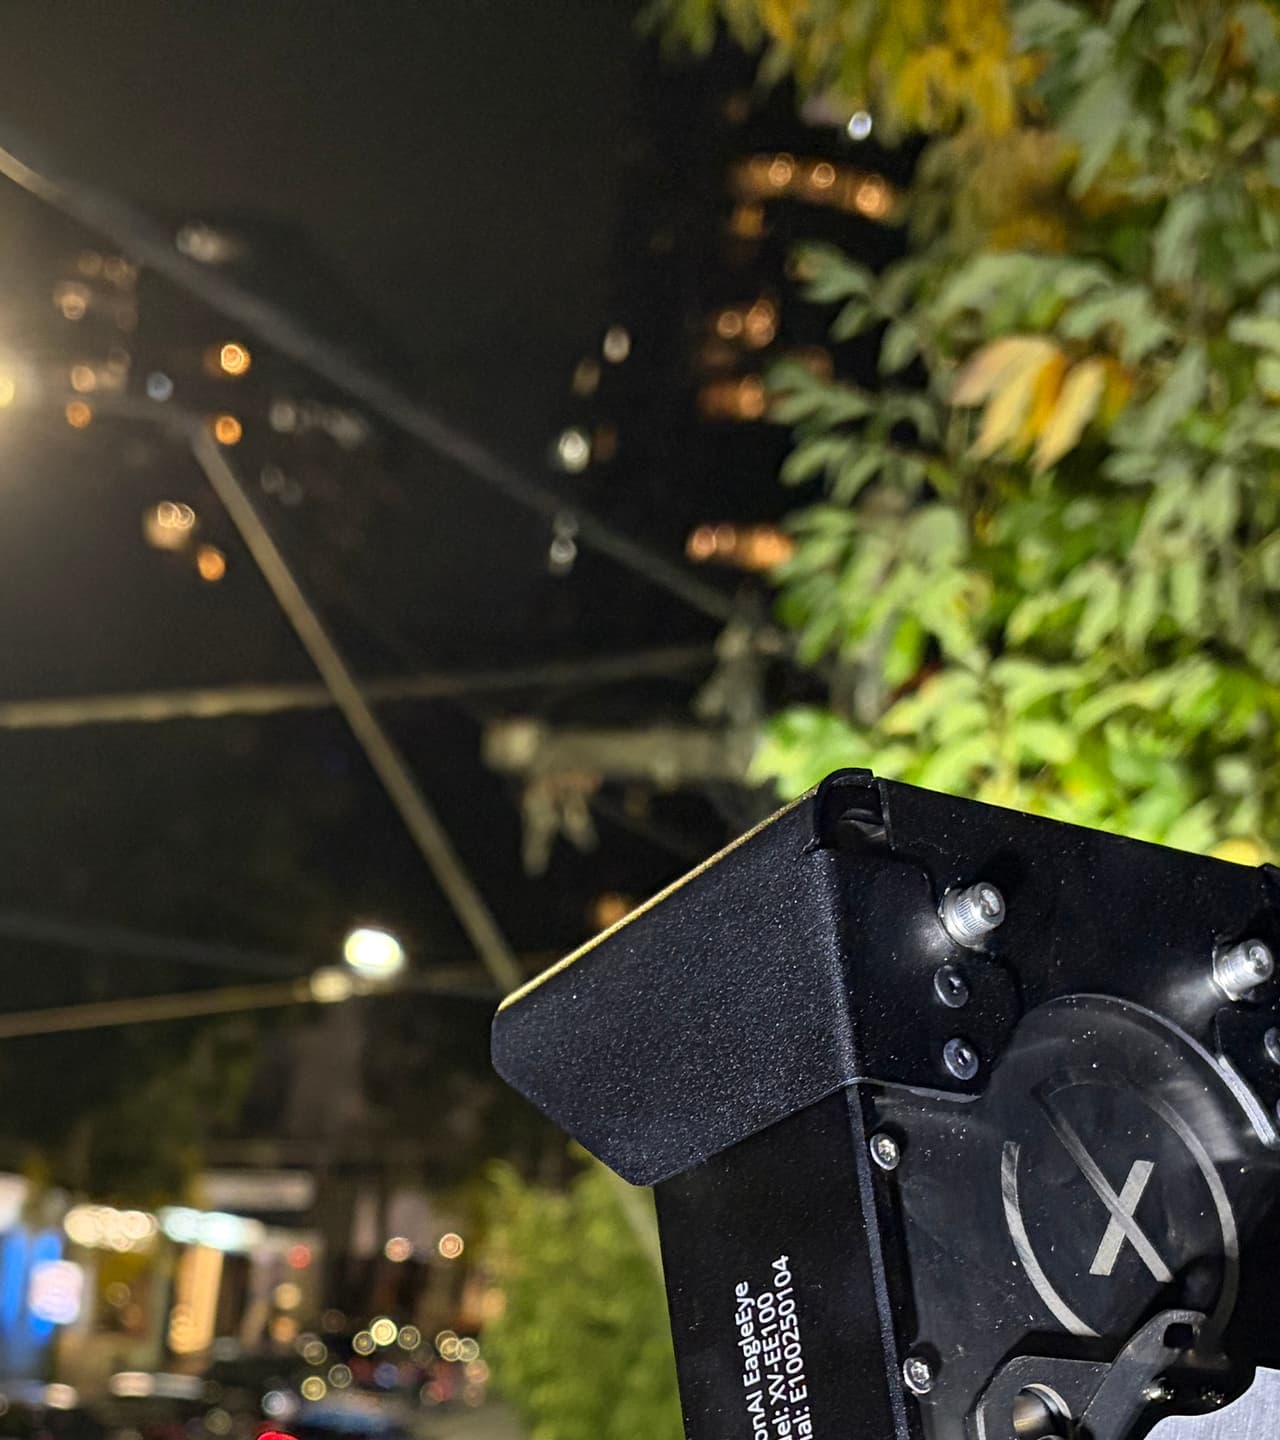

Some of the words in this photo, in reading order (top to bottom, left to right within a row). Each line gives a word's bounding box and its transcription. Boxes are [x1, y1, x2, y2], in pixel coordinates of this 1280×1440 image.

[733, 1281, 762, 1388] EagleEye
[756, 1292, 788, 1405] XV-EE100
[771, 1255, 808, 1403] E100250104
